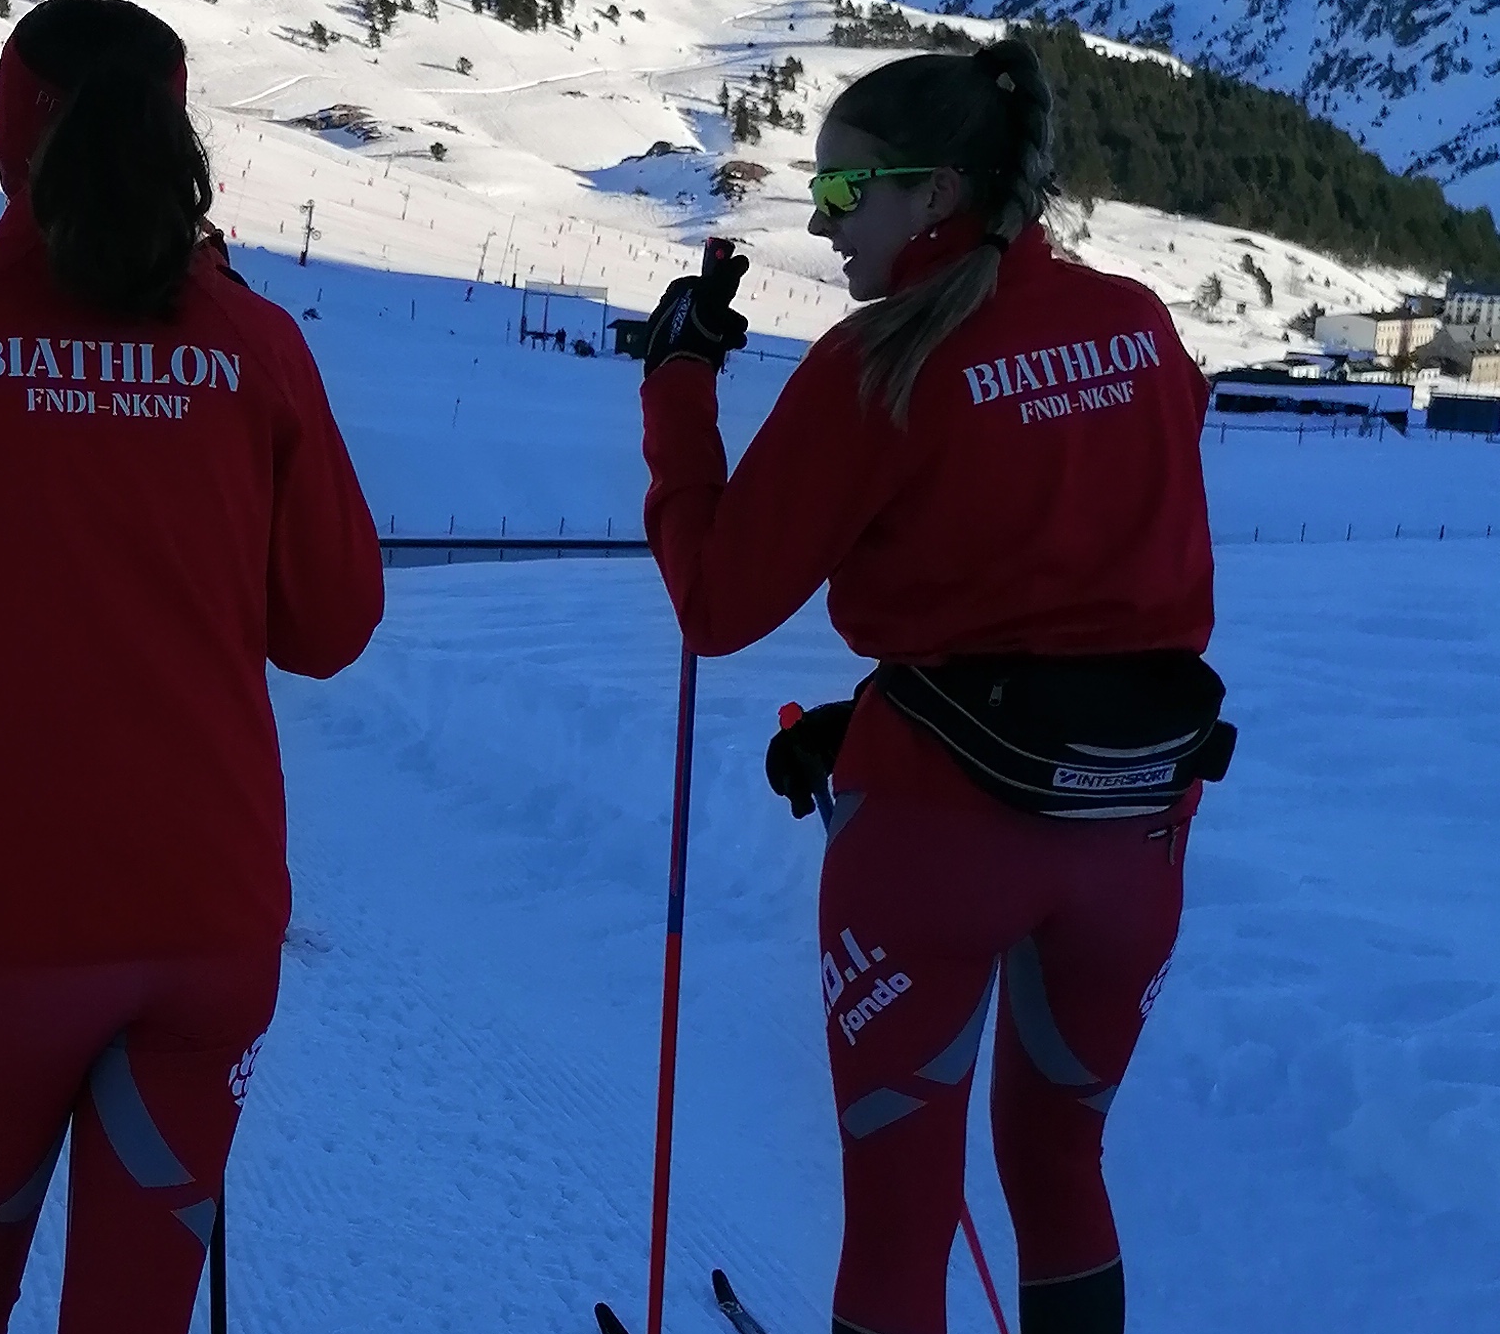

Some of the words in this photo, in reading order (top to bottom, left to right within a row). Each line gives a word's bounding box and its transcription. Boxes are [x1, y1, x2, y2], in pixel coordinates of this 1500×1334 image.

[963, 330, 1161, 405] BIATHLON
[26, 388, 191, 420] FNDI-NKNF
[1018, 380, 1135, 425] FNDI-NKNF
[838, 971, 914, 1047] fondo
